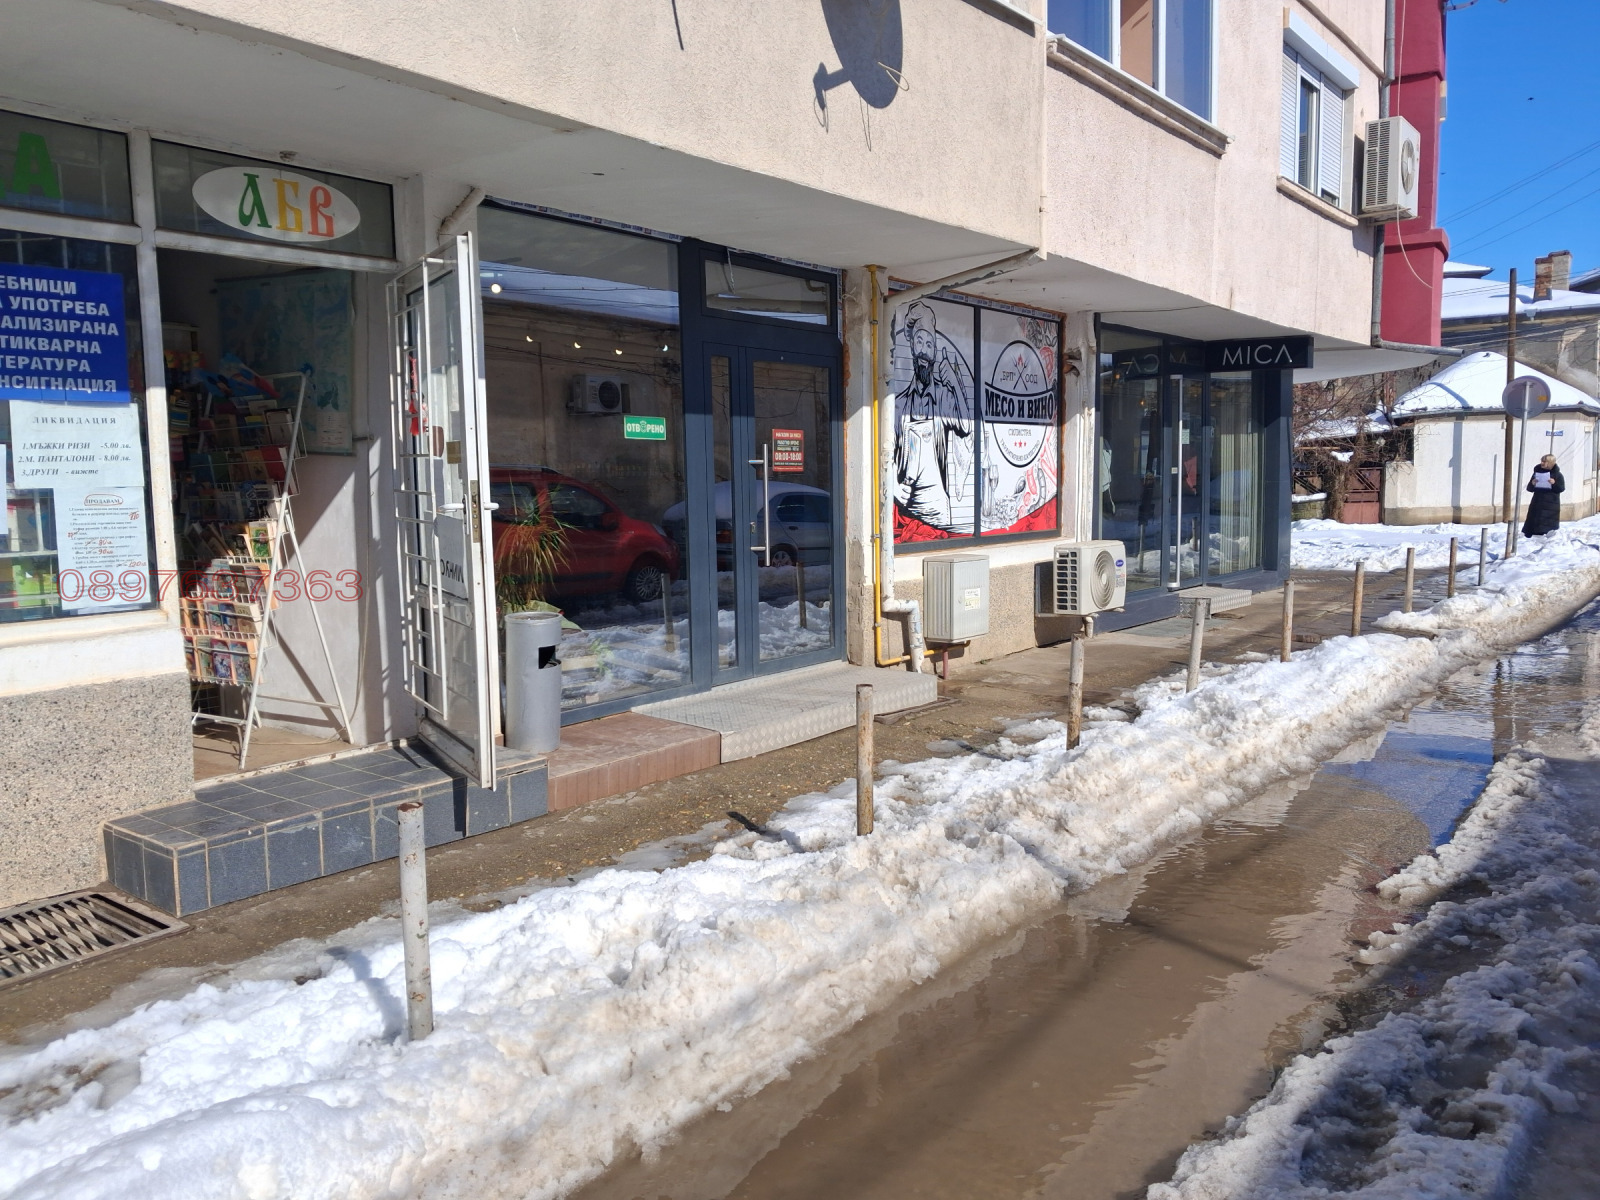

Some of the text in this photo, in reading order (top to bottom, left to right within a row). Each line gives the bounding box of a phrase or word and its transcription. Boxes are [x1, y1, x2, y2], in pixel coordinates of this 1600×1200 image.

[238, 172, 335, 238] АБВ
[9, 295, 110, 317] УПОТРЕБА
[0, 314, 119, 336] АЛИЗИРАНА
[1222, 344, 1293, 366] MICA
[0, 375, 117, 394] НСИГНАЦИЯ
[1025, 373, 1038, 384] ООД
[985, 387, 1054, 420] МЕСО И ВИНО
[32, 416, 117, 425] ЛИКВИДАЦИЯ
[67, 442, 91, 450] РИЗИ
[38, 454, 95, 463] ПАНТАЛОНИ
